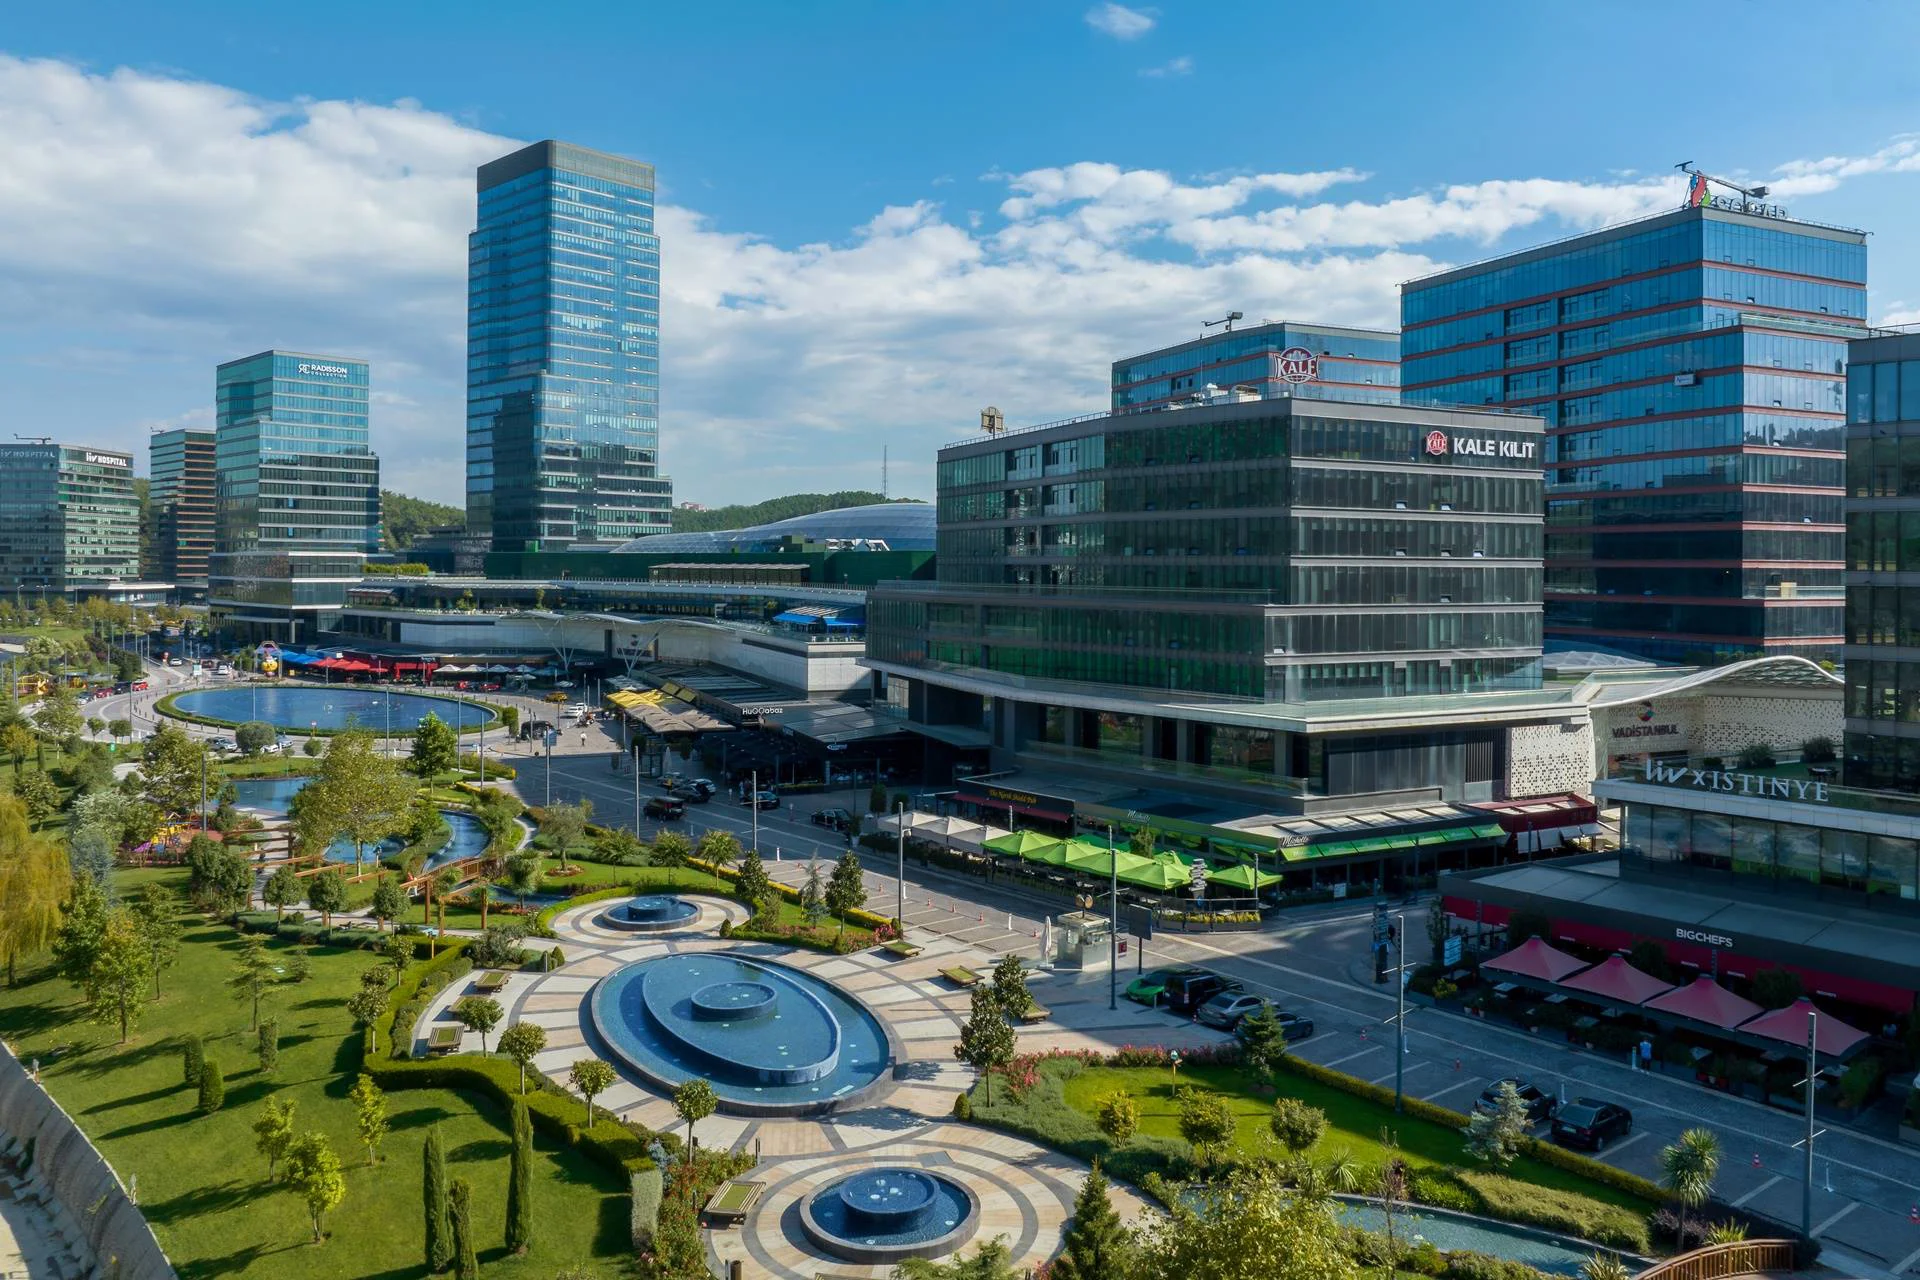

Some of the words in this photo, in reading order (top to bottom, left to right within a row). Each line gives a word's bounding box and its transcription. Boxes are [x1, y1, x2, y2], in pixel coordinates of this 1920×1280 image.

[311, 364, 348, 375] RADISSON
[1277, 356, 1317, 378] KALE
[1453, 437, 1496, 456] KALE
[98, 456, 127, 466] HOSPITAL
[1676, 927, 1733, 948] BIGCHEFS
